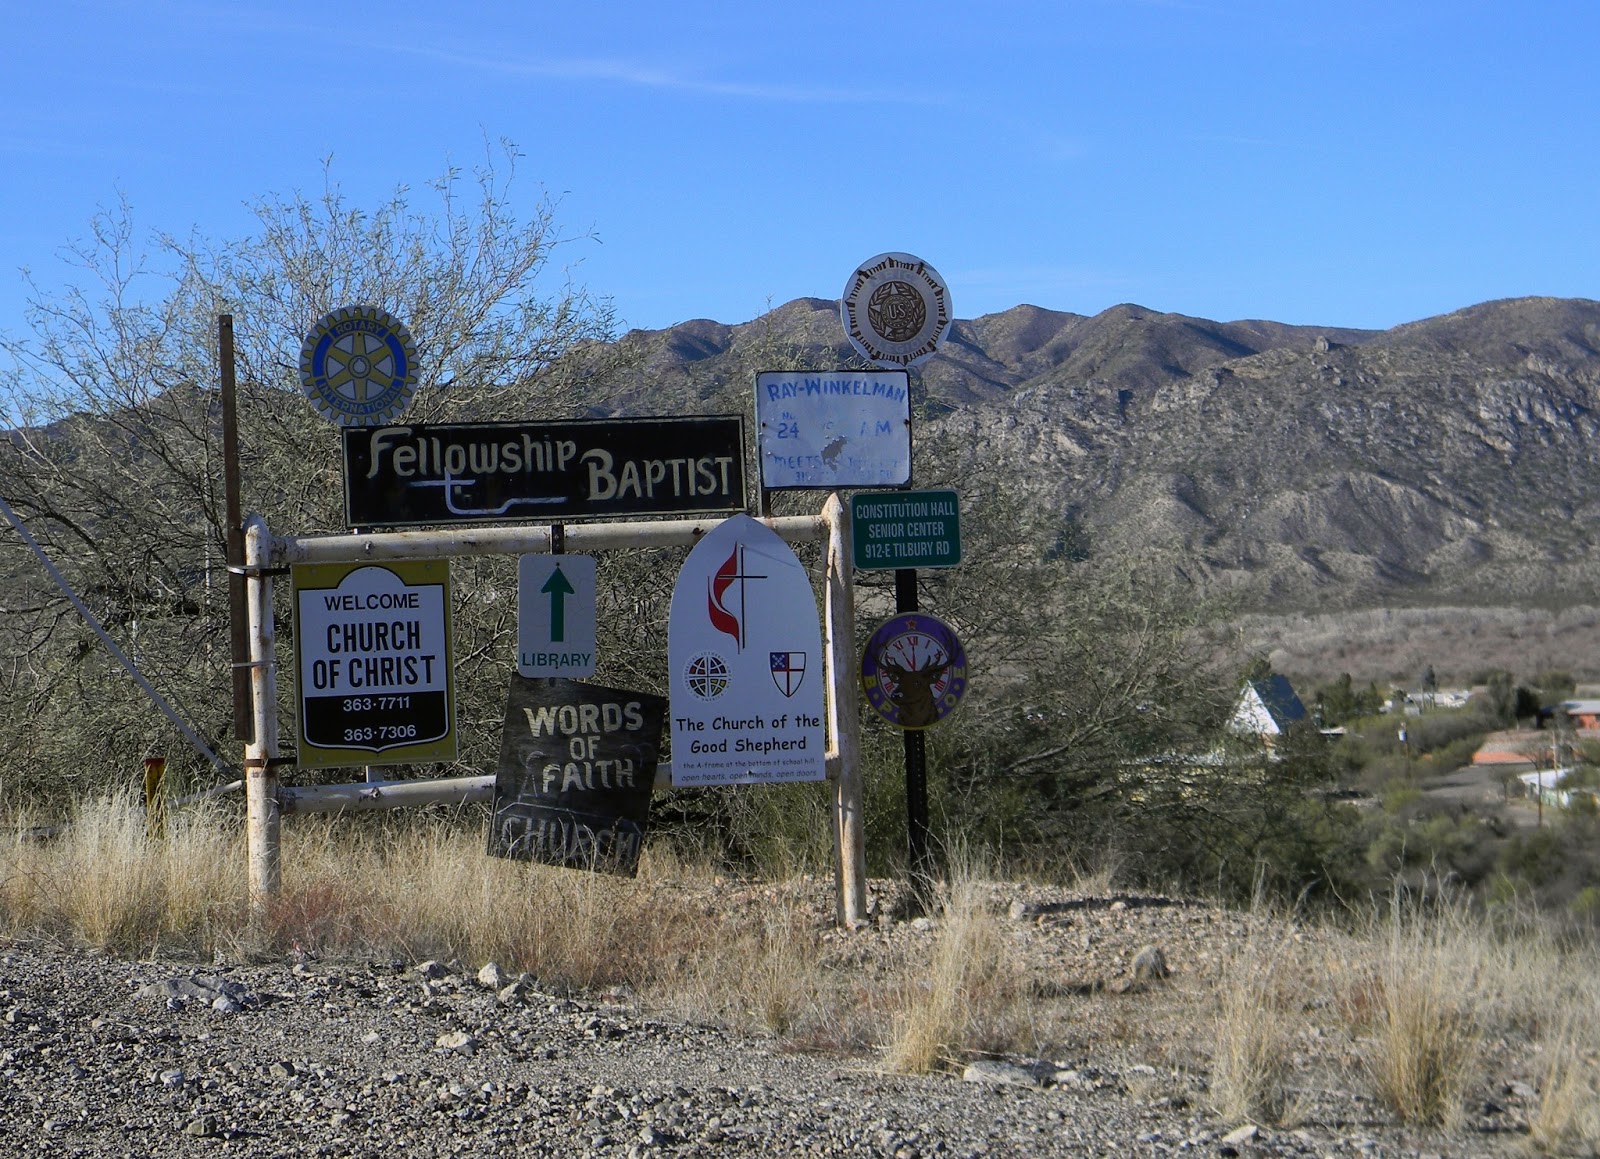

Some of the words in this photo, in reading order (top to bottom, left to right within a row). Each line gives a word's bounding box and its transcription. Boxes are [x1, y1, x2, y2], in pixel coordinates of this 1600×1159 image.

[336, 321, 384, 334] ROTARY
[319, 383, 400, 414] INTERNATIONAL
[767, 377, 906, 403] RAY-WINKELMAN
[777, 422, 799, 439] 24
[366, 427, 576, 479] Fellowship
[580, 448, 733, 500] BAPTIST
[856, 502, 929, 519] CONSTITUTION
[931, 501, 955, 516] HALL
[868, 523, 905, 538] SENIOR
[907, 522, 945, 537] CENTER
[893, 541, 933, 557] TILBURY
[936, 541, 950, 555] RD
[324, 593, 419, 611] WELCOME
[327, 621, 421, 653] CHURCH
[522, 653, 591, 667] LIBRARY
[312, 660, 340, 689] OF
[349, 655, 435, 688] CHRIST
[523, 701, 644, 738] WORDS
[676, 718, 705, 731] The
[712, 715, 764, 730] Church
[771, 714, 788, 728] of
[795, 713, 820, 727] the
[569, 736, 601, 761] OF
[690, 739, 727, 754] Good
[735, 736, 806, 755] Shepherd
[696, 761, 724, 769] A-frame
[782, 758, 803, 766] school
[542, 758, 635, 793] FAITH
[681, 774, 700, 782] open
[729, 773, 748, 781] open
[796, 769, 817, 777] doors
